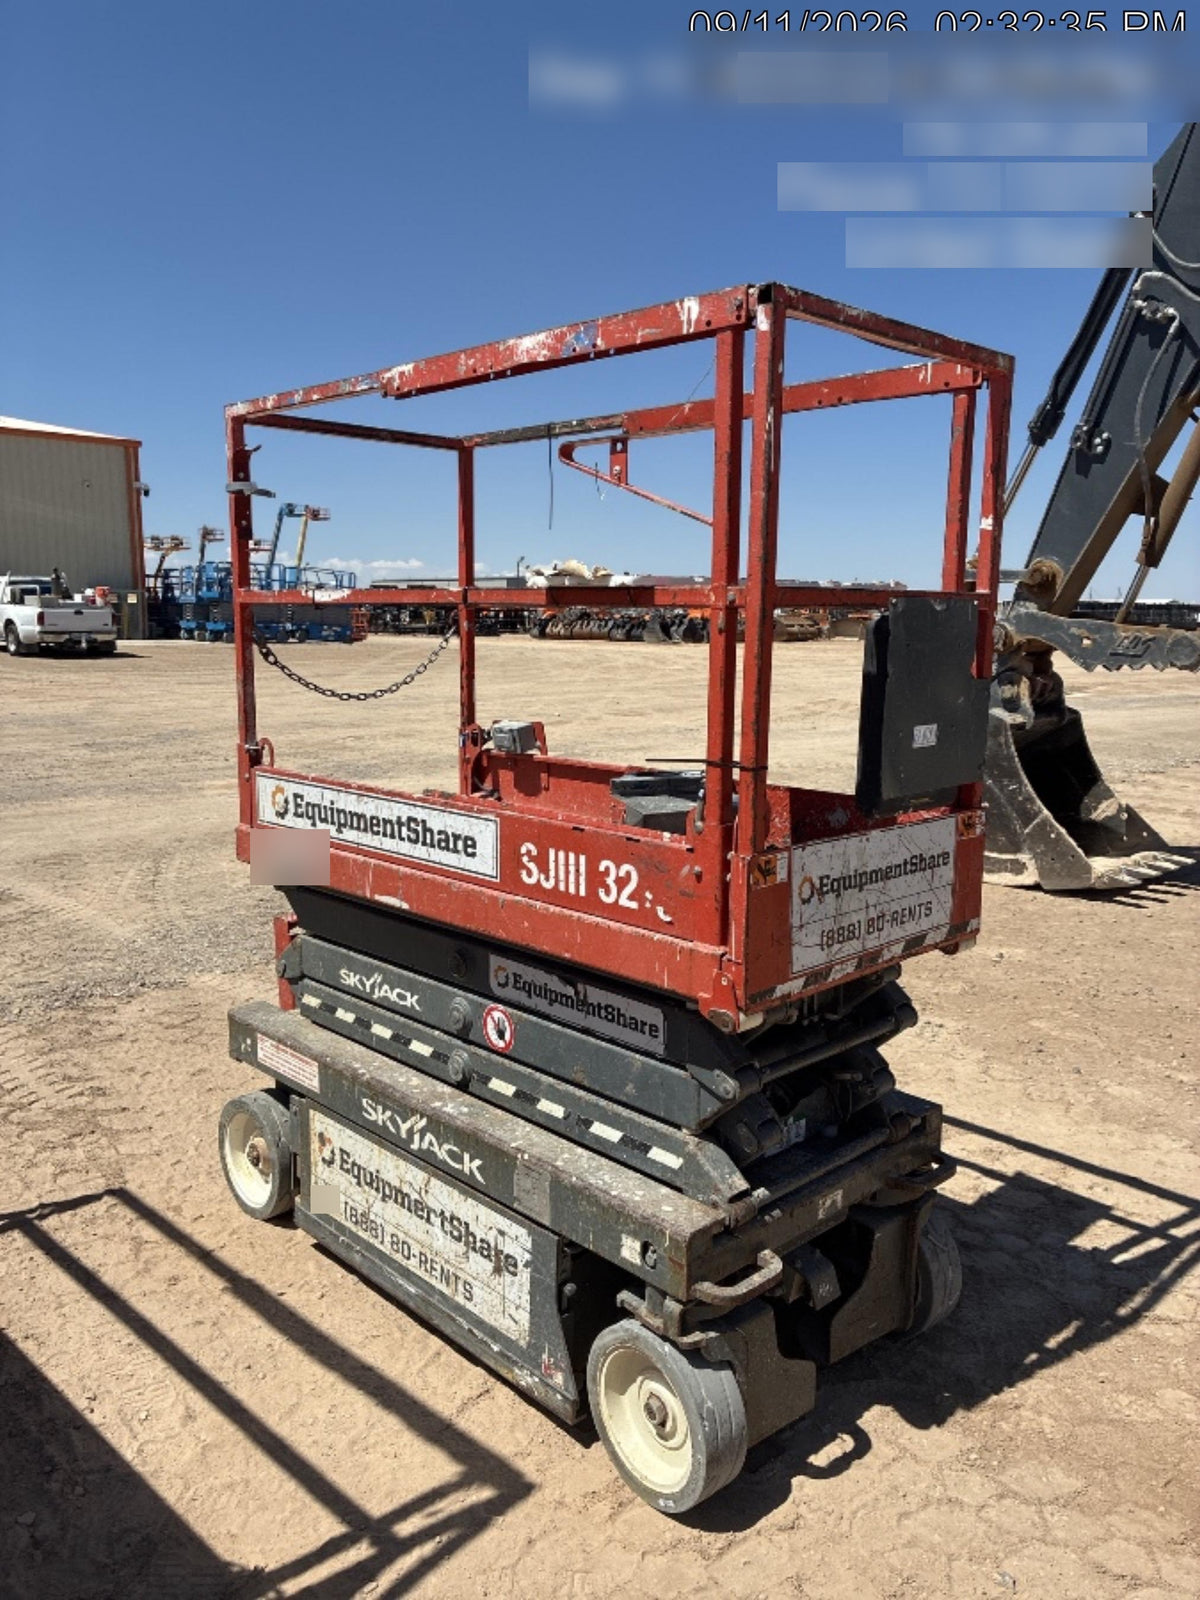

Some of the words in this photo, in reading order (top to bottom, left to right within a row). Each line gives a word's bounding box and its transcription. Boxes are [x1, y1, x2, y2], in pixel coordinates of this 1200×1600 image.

[292, 792, 477, 858] EquipmentShare
[818, 850, 951, 898] EquipmentShare
[820, 919, 861, 951] (888)
[866, 901, 933, 936] 80-RENTS
[339, 968, 422, 1012] SKYJACK
[512, 972, 660, 1039] EquipmentShare
[361, 1098, 486, 1185] SKYJACK
[390, 1232, 474, 1302] 80-RENTS
